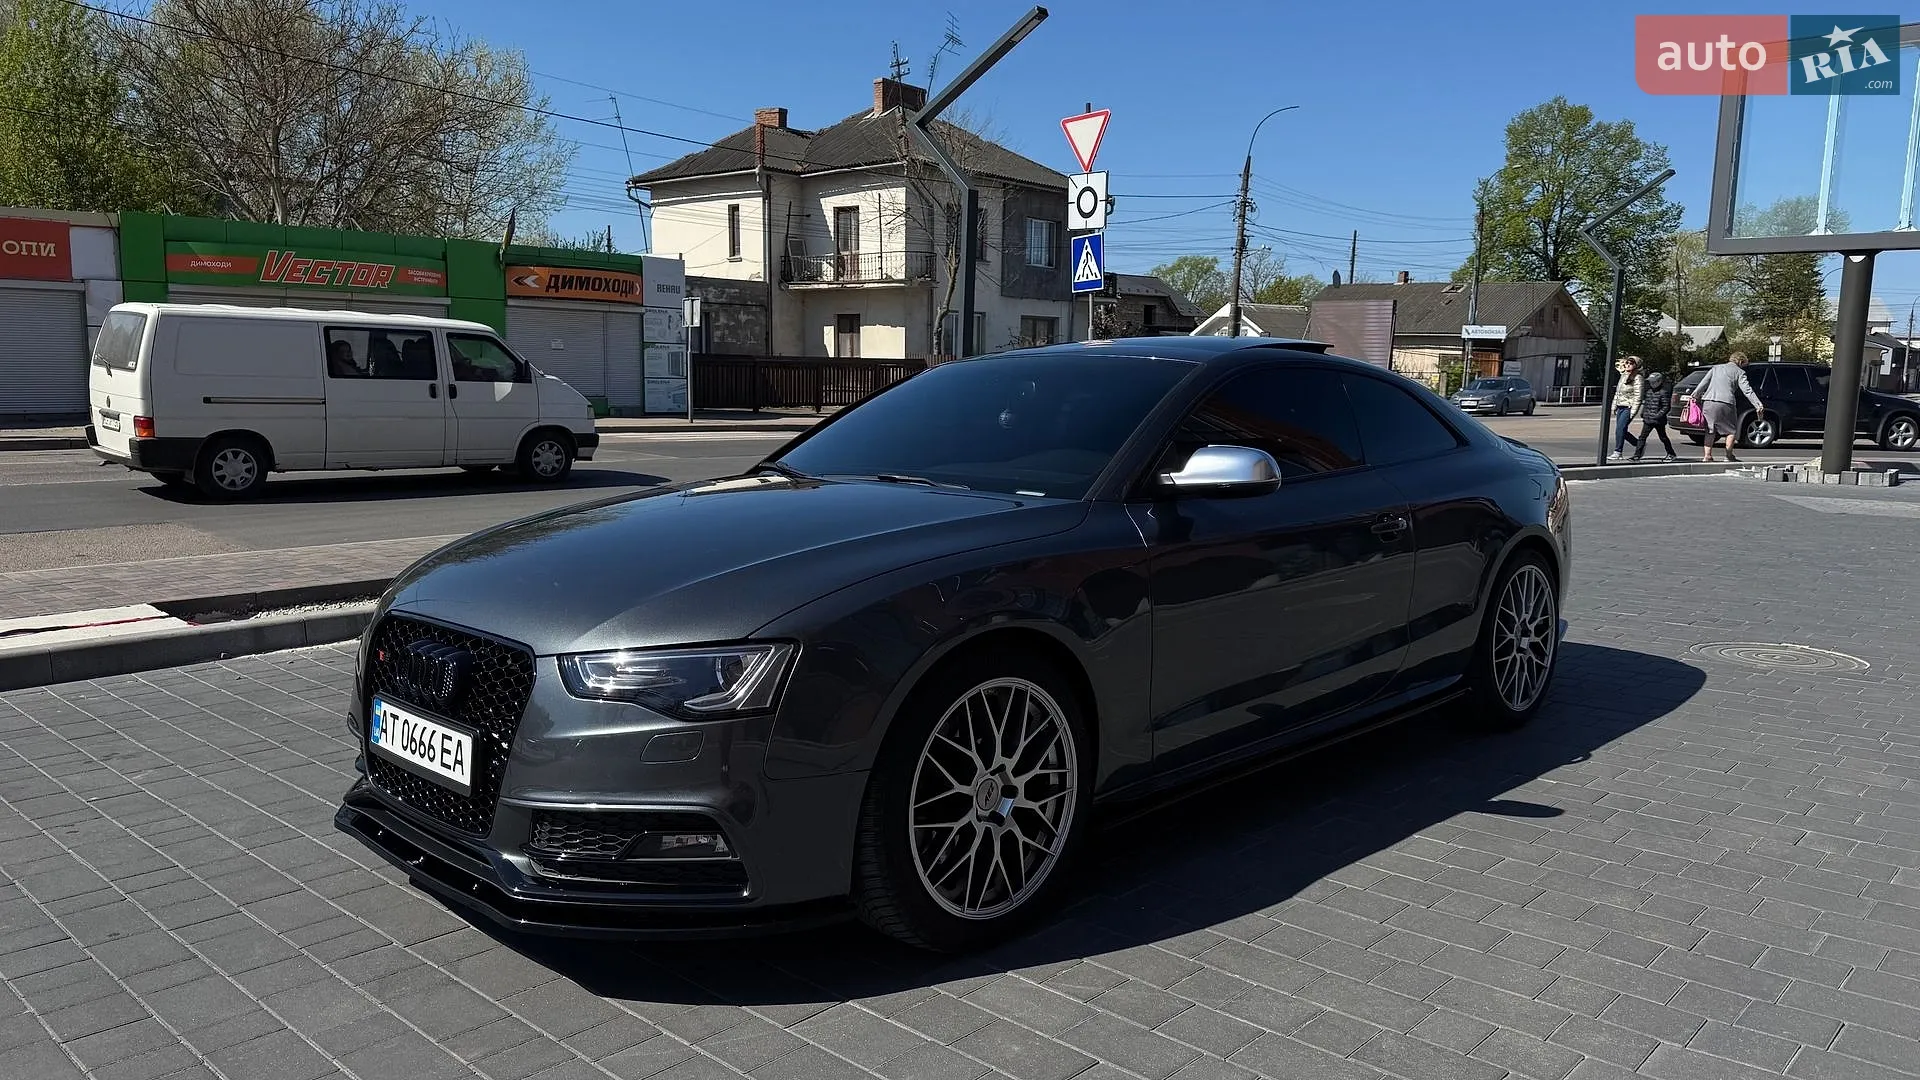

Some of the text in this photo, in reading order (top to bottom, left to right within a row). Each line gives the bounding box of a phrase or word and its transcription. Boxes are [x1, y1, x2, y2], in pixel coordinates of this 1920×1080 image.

[190, 260, 232, 269] ДИМОХОДИ
[545, 274, 634, 297] ДИМОХОДИ
[656, 284, 681, 294] REHAU
[380, 709, 464, 775] AT 0666 EA
